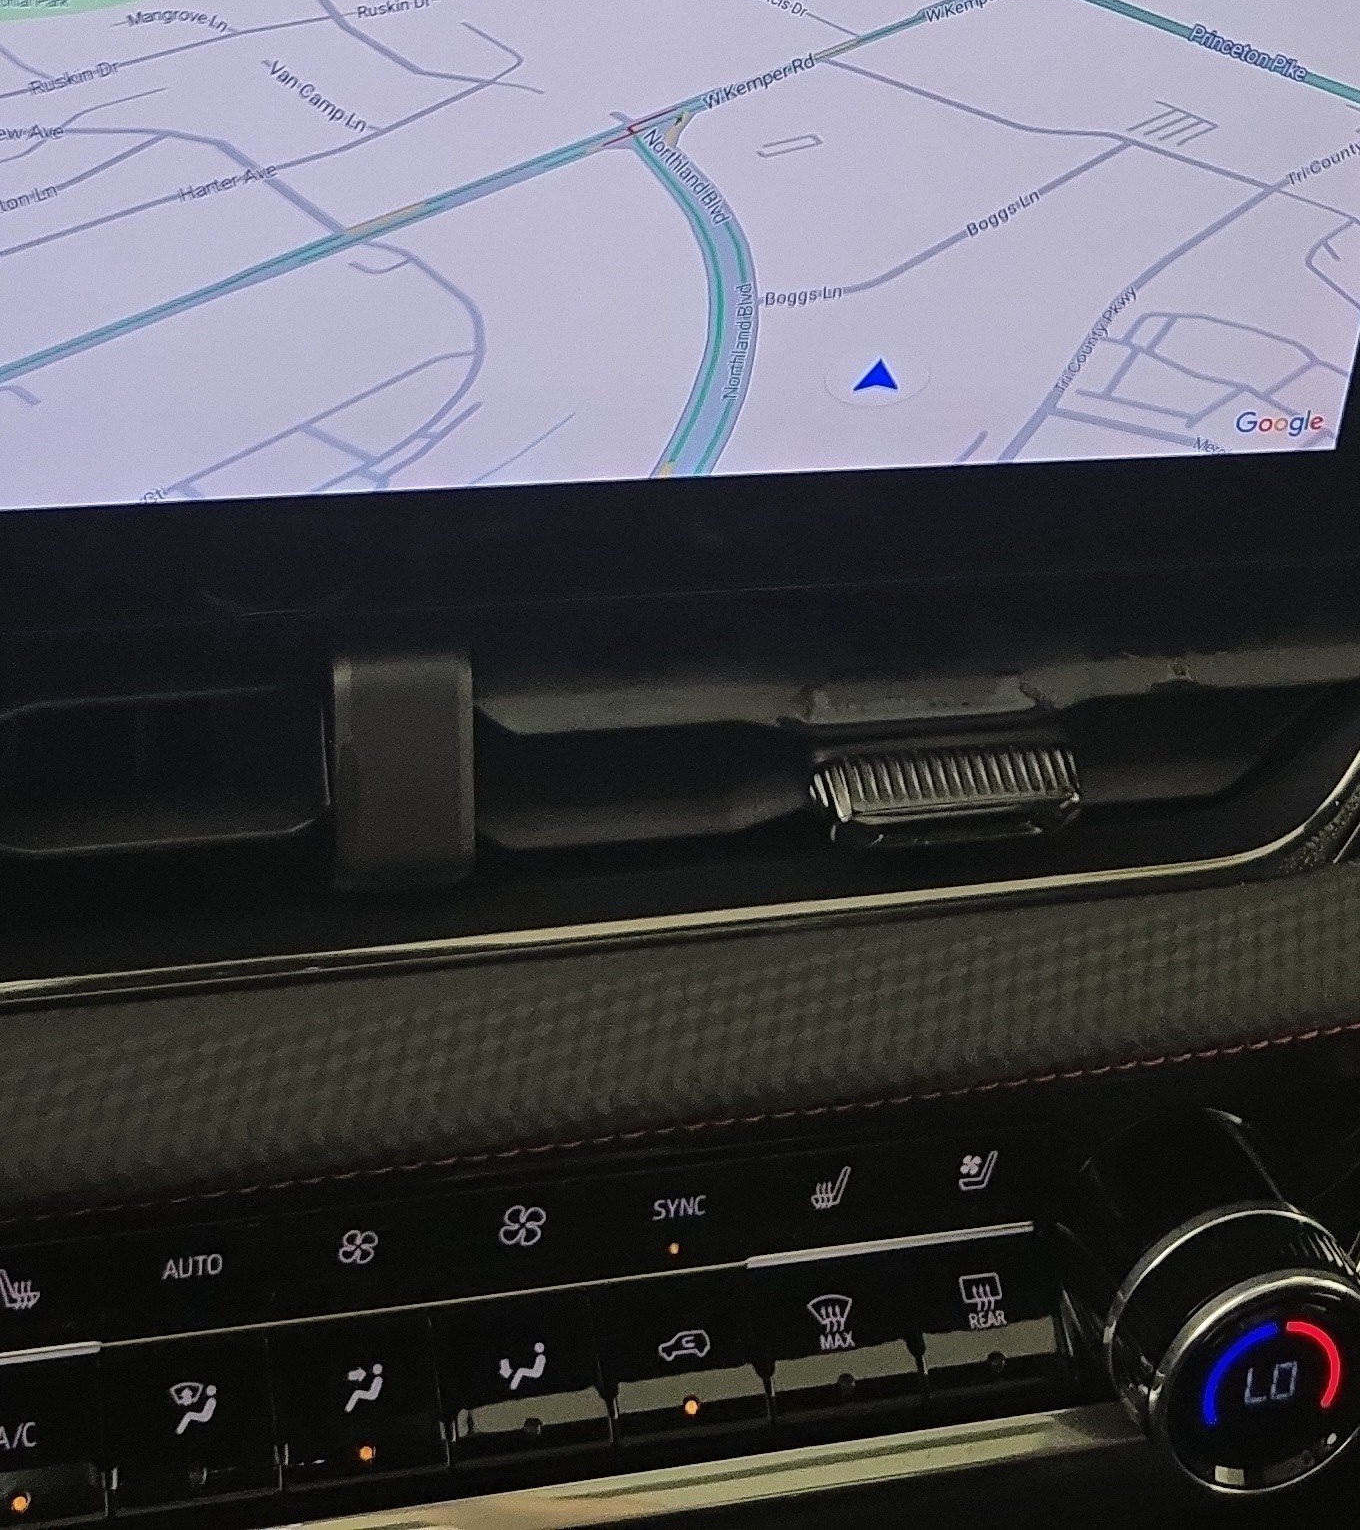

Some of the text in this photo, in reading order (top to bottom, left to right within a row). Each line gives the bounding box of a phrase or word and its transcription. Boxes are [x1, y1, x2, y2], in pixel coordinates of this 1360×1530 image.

[126, 10, 230, 33] Mangrove Ln
[790, 0, 809, 19] Dr
[924, 7, 942, 23] W
[1190, 23, 1308, 83] Princeton Pike
[28, 61, 120, 96] Ruskin Dr
[702, 51, 817, 110] W Kemper Rd
[268, 59, 368, 133] Van Camp Ln
[26, 122, 65, 140] Ave
[242, 162, 279, 185] Ave
[642, 126, 730, 227] Northland Blvd
[33, 183, 59, 203] Ln
[966, 189, 1041, 238] Boggs Ln
[764, 284, 844, 308] Boggs Ln
[721, 282, 755, 402] Northland Blvd
[1068, 325, 1109, 373] County
[1101, 285, 1139, 326] Pkwy
[1236, 410, 1324, 437] Google
[653, 1194, 707, 1222] SYNC
[162, 1253, 224, 1281] AUTO
[968, 1307, 1008, 1330] REAR
[819, 1330, 855, 1351] MAX
